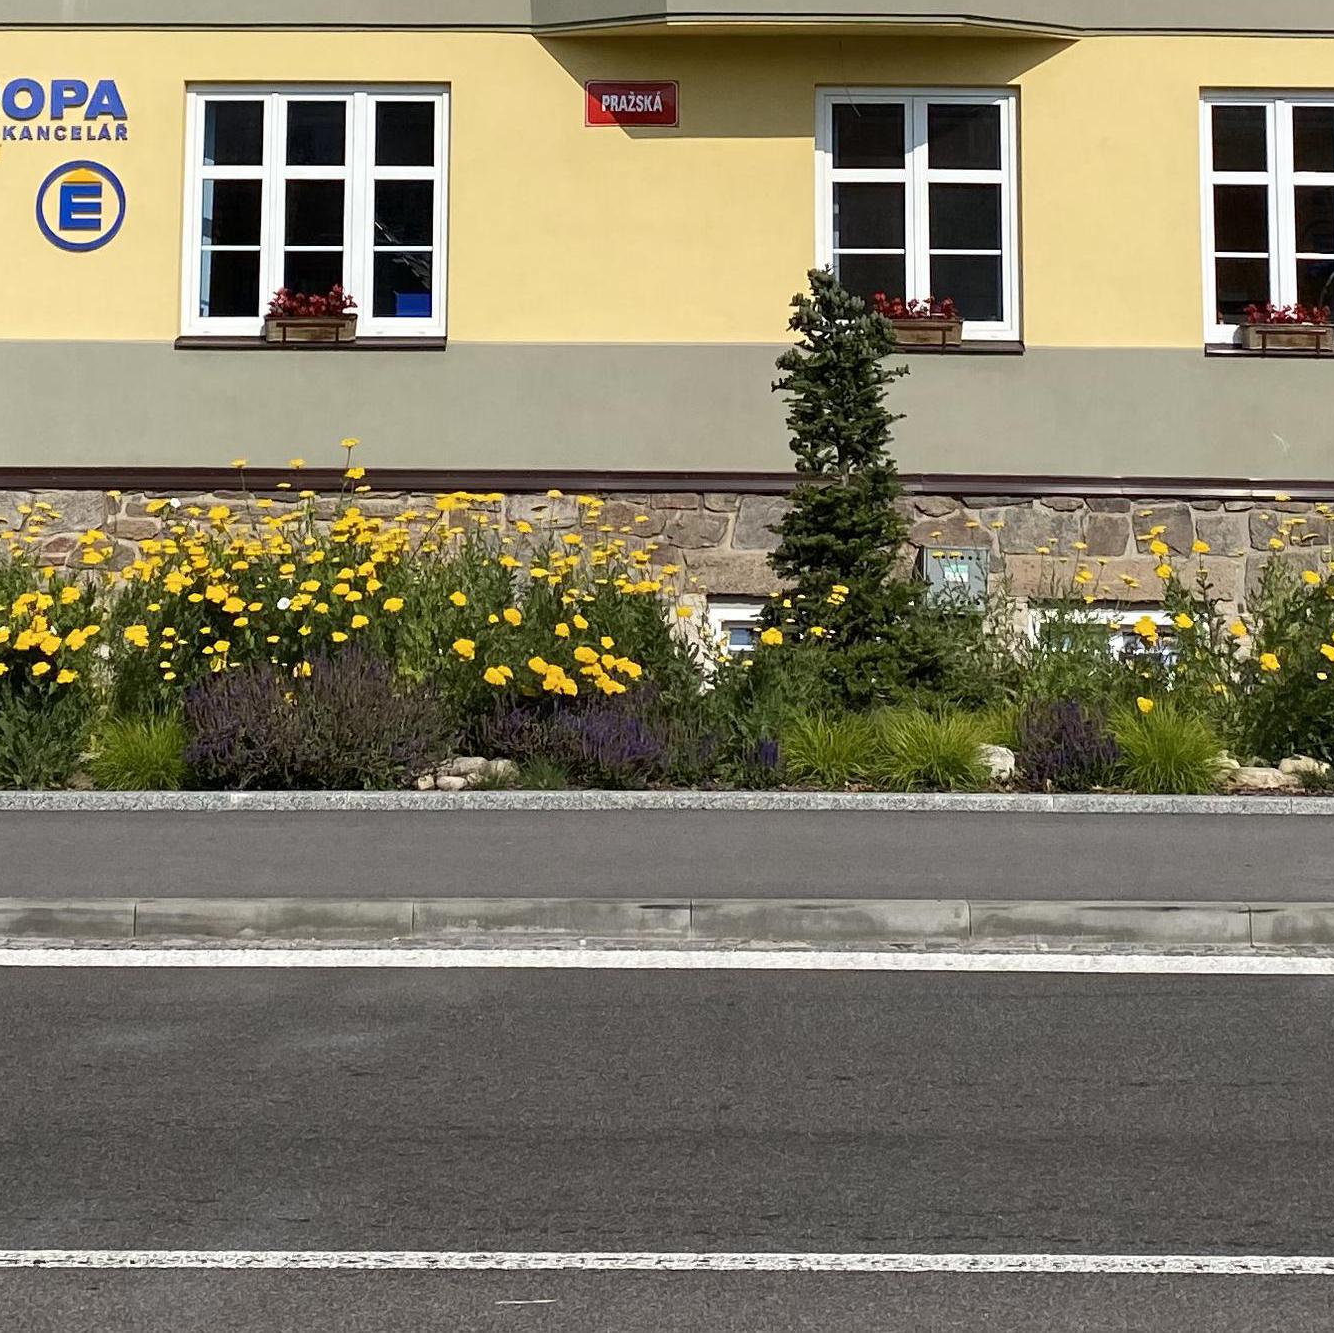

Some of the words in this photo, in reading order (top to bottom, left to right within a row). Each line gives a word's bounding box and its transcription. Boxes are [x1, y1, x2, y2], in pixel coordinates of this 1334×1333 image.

[601, 91, 663, 112] PRAŽSKÁ
[2, 123, 129, 141] KANCELÁŘ
[59, 181, 103, 231] E
